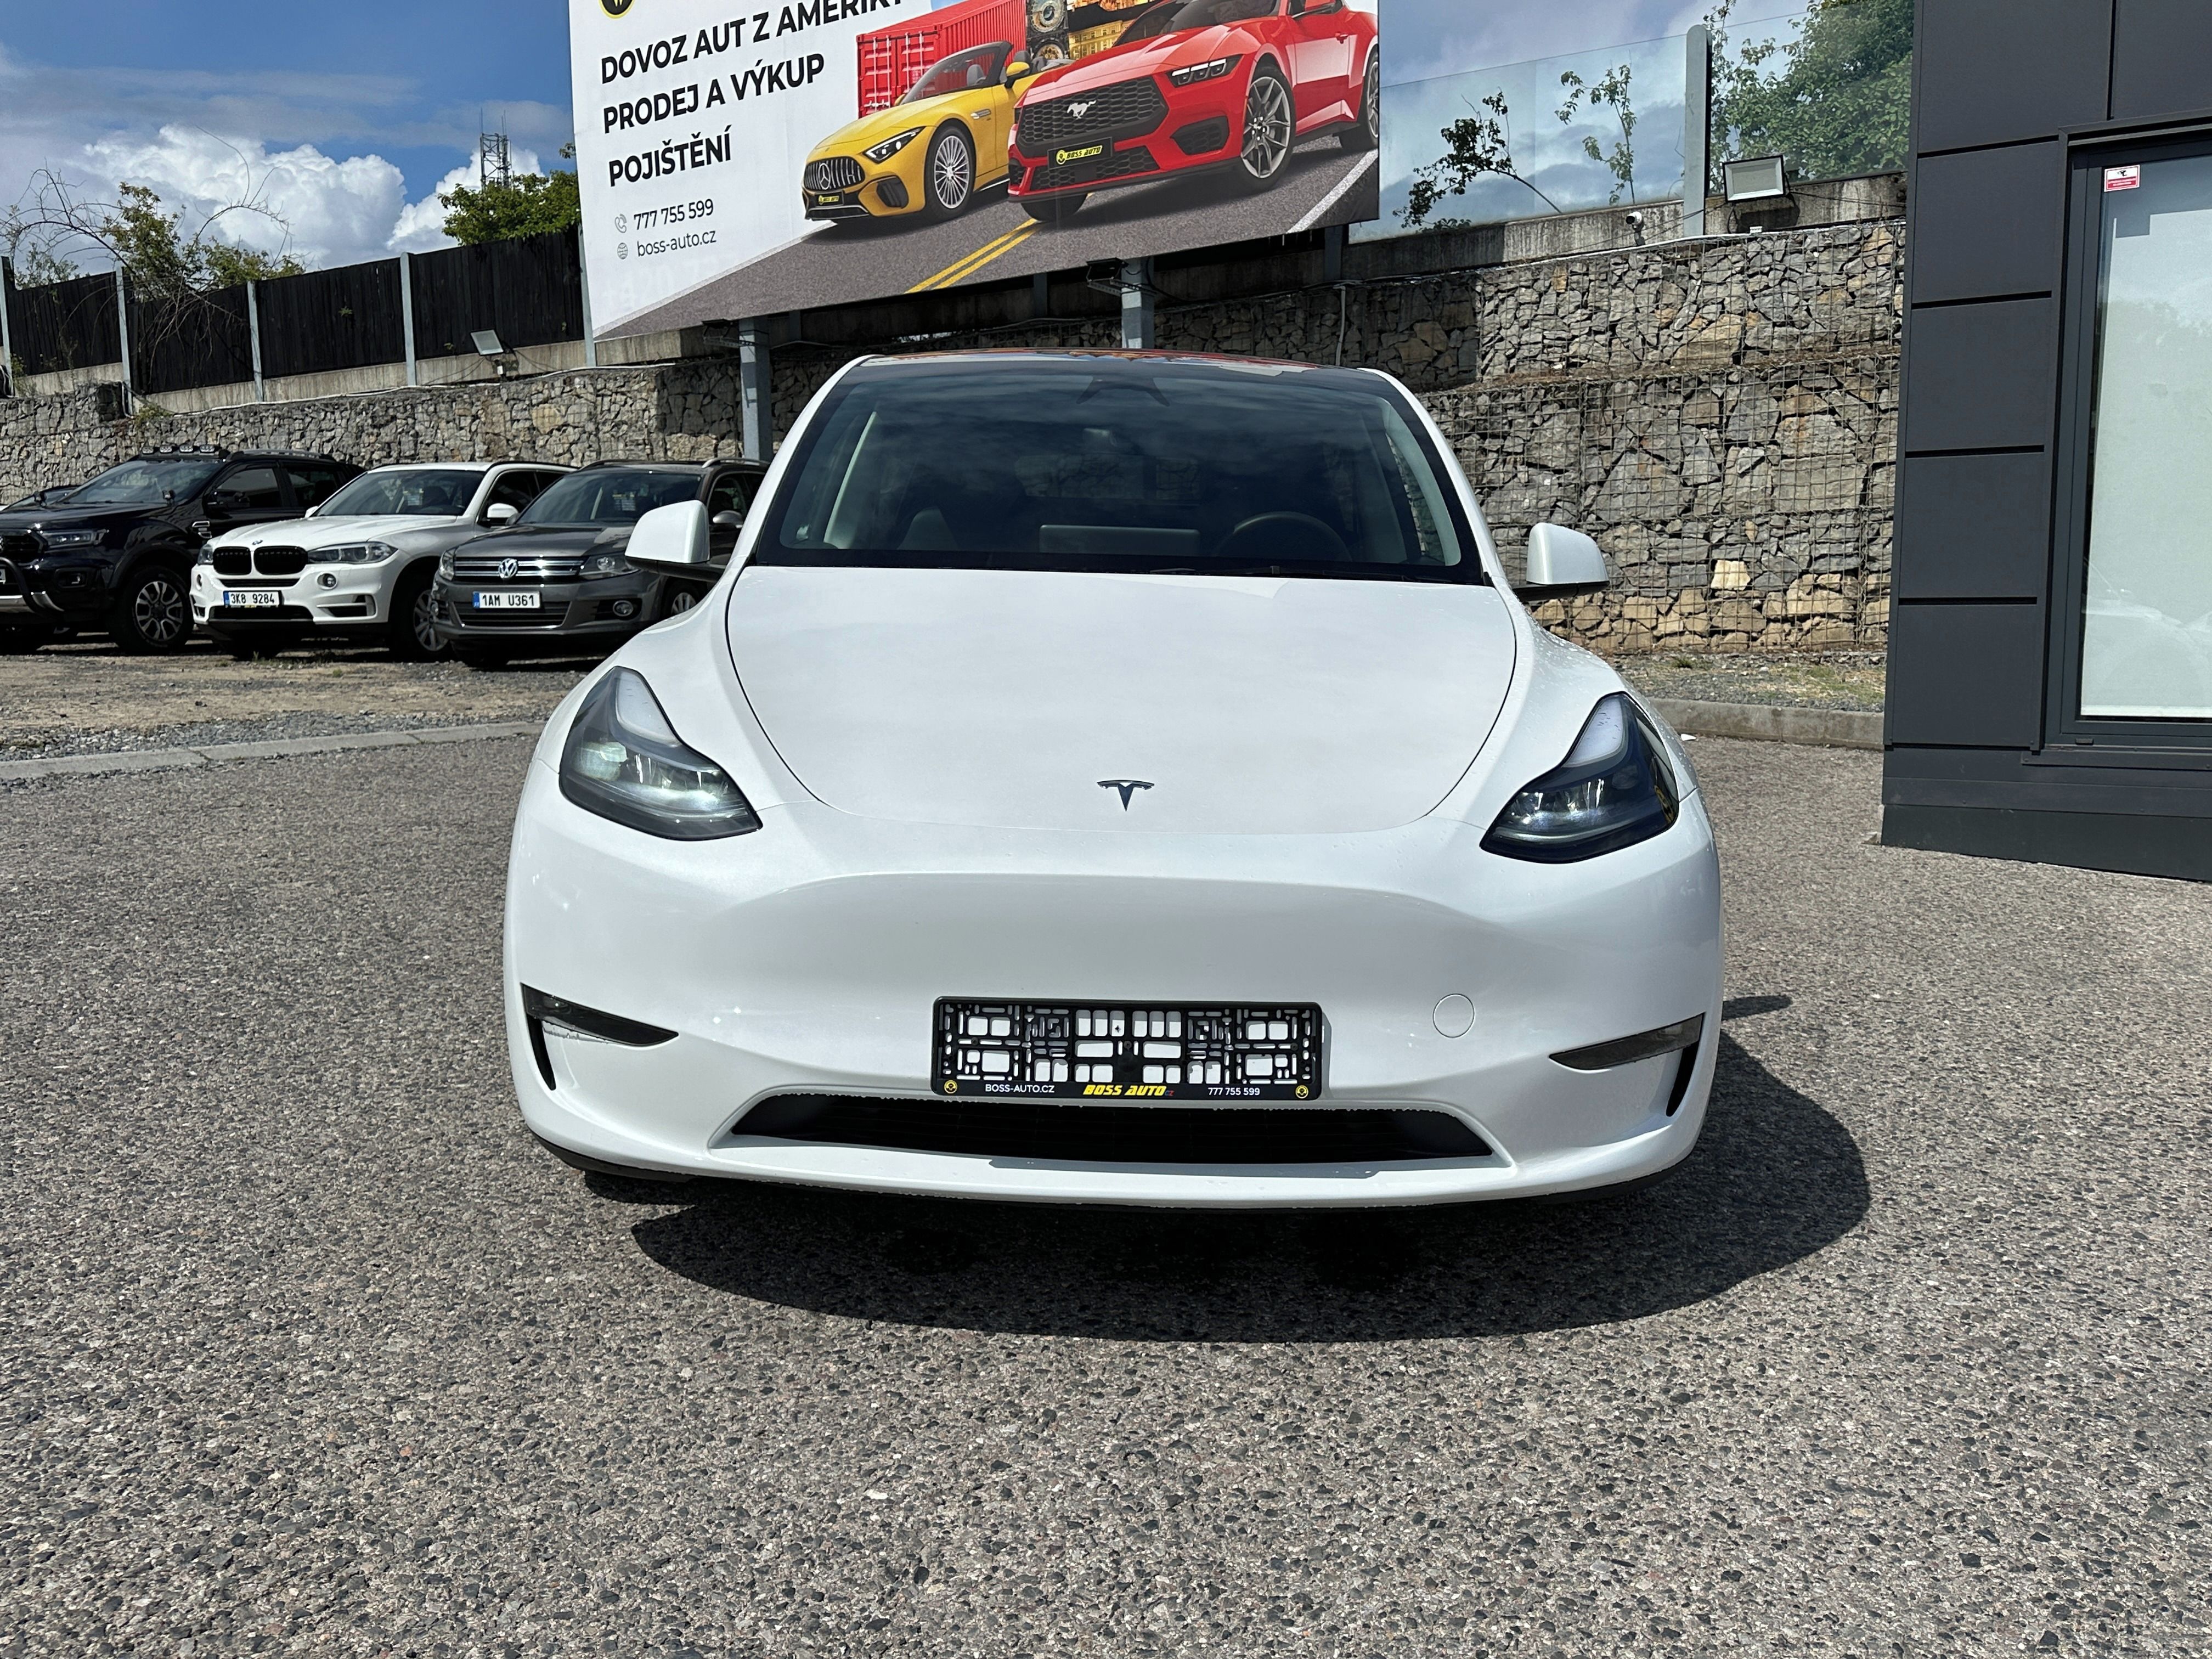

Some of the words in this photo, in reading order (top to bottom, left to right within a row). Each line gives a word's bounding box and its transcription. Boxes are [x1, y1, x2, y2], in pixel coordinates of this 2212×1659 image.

[601, 34, 687, 84] DOVOZ
[693, 18, 746, 59] AUT
[753, 11, 770, 43] Z
[603, 84, 698, 134] PRODEJ
[706, 78, 726, 108] A
[730, 53, 824, 101] VÝKUP
[609, 125, 732, 187] POJIŠTĚNÍ
[1066, 150, 1082, 159] BOSS
[1084, 146, 1101, 156] AUTO
[634, 210, 657, 230] 777
[661, 205, 685, 224] 755
[689, 199, 713, 219] 599
[637, 230, 716, 257] boss-auto.cz
[230, 594, 246, 603] 3K8
[252, 594, 274, 603] 9284
[482, 595, 500, 606] 1AM
[508, 595, 534, 606] U361
[985, 1084, 1054, 1093] BOSS-AUTO.CZ
[1083, 1085, 1122, 1095] BOSS
[1207, 1087, 1223, 1096] 777
[1225, 1087, 1241, 1096] 755
[1243, 1087, 1260, 1096] 599
